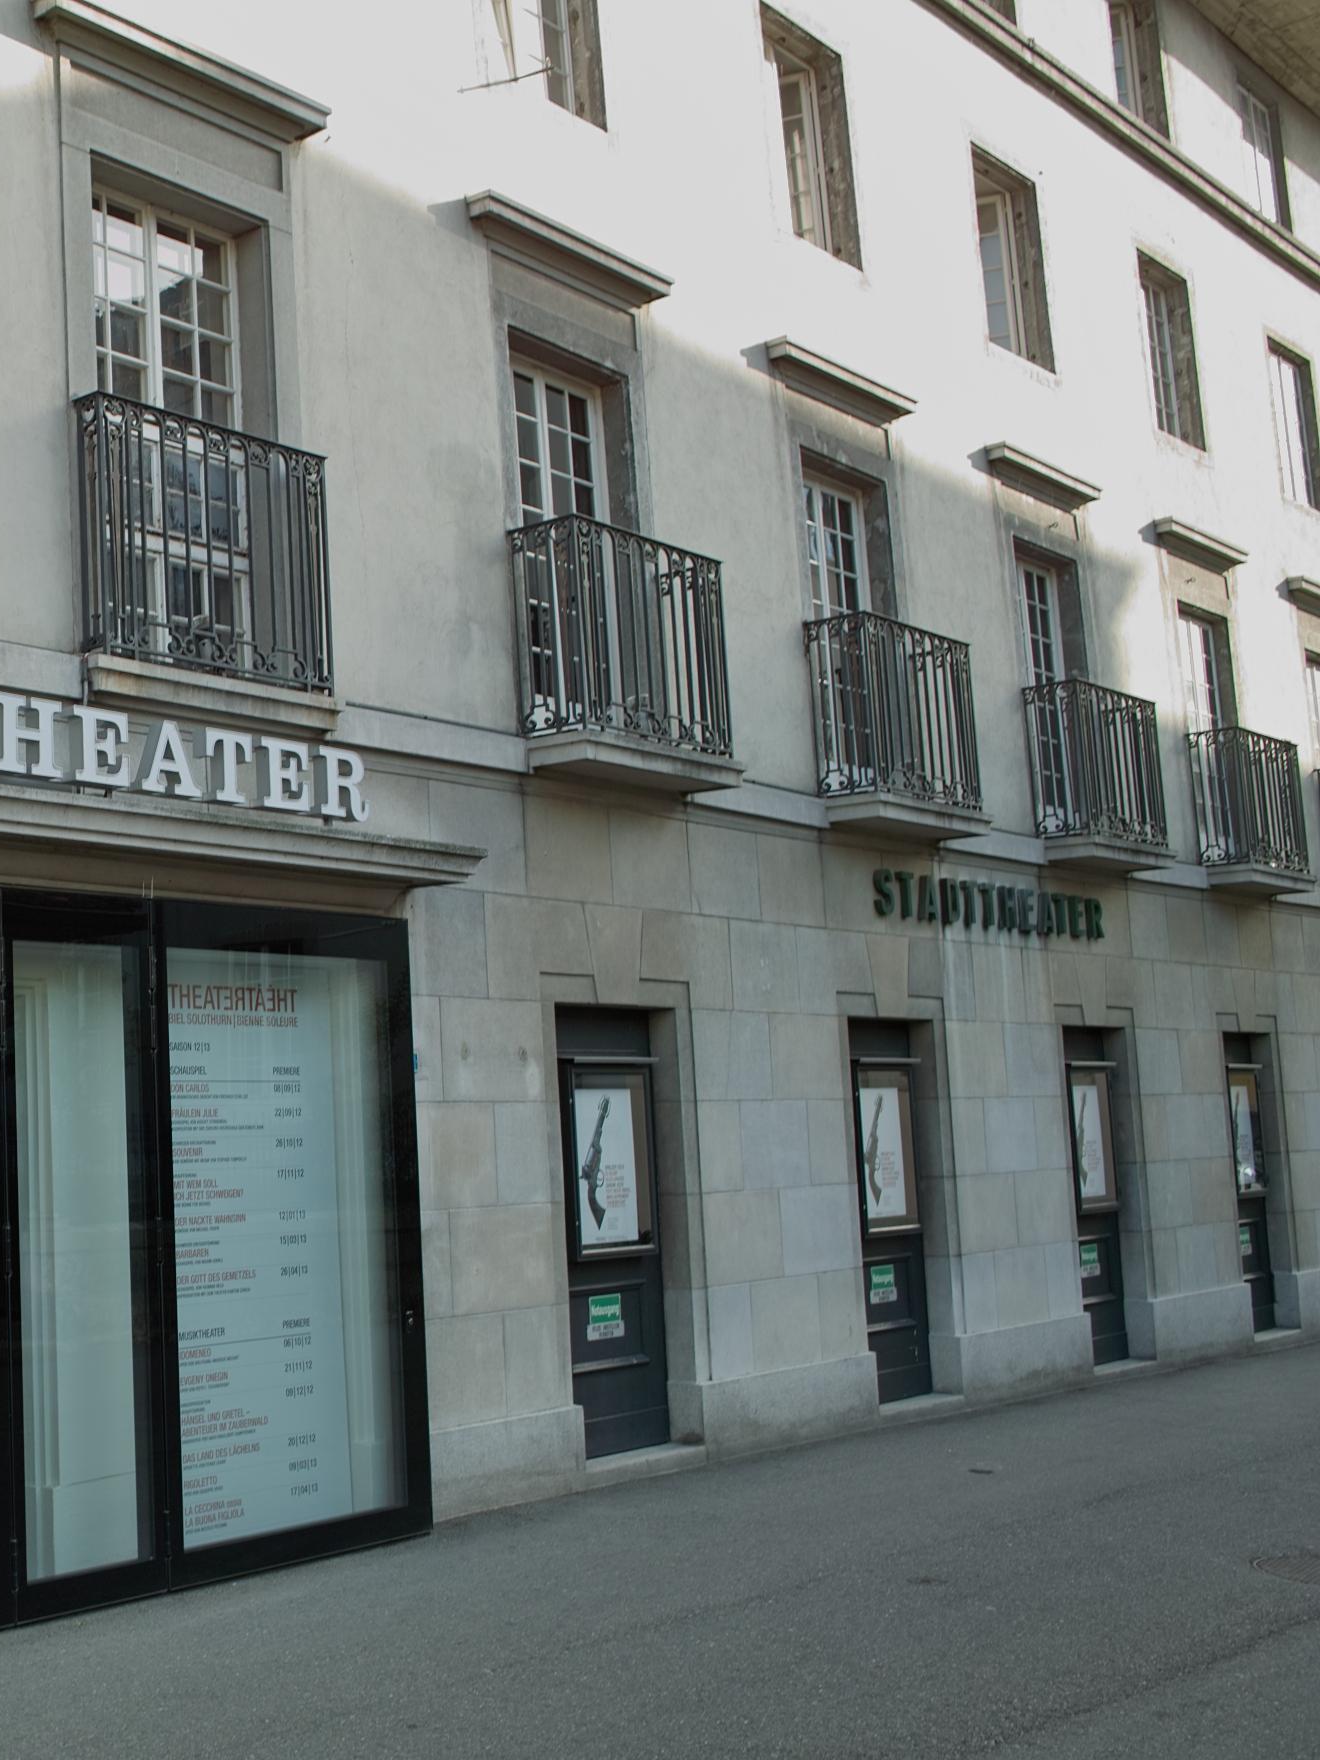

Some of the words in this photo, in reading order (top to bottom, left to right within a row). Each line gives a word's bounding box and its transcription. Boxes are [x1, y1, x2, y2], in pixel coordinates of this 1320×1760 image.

[873, 868, 1105, 941] STADTTHEATER
[187, 1013, 232, 1026] SOLOTHURN
[237, 1015, 264, 1027] BIENNE
[267, 1016, 298, 1028] SOLEURE
[273, 1066, 300, 1076] PREMIERE
[282, 1317, 310, 1329] PREMIERE
